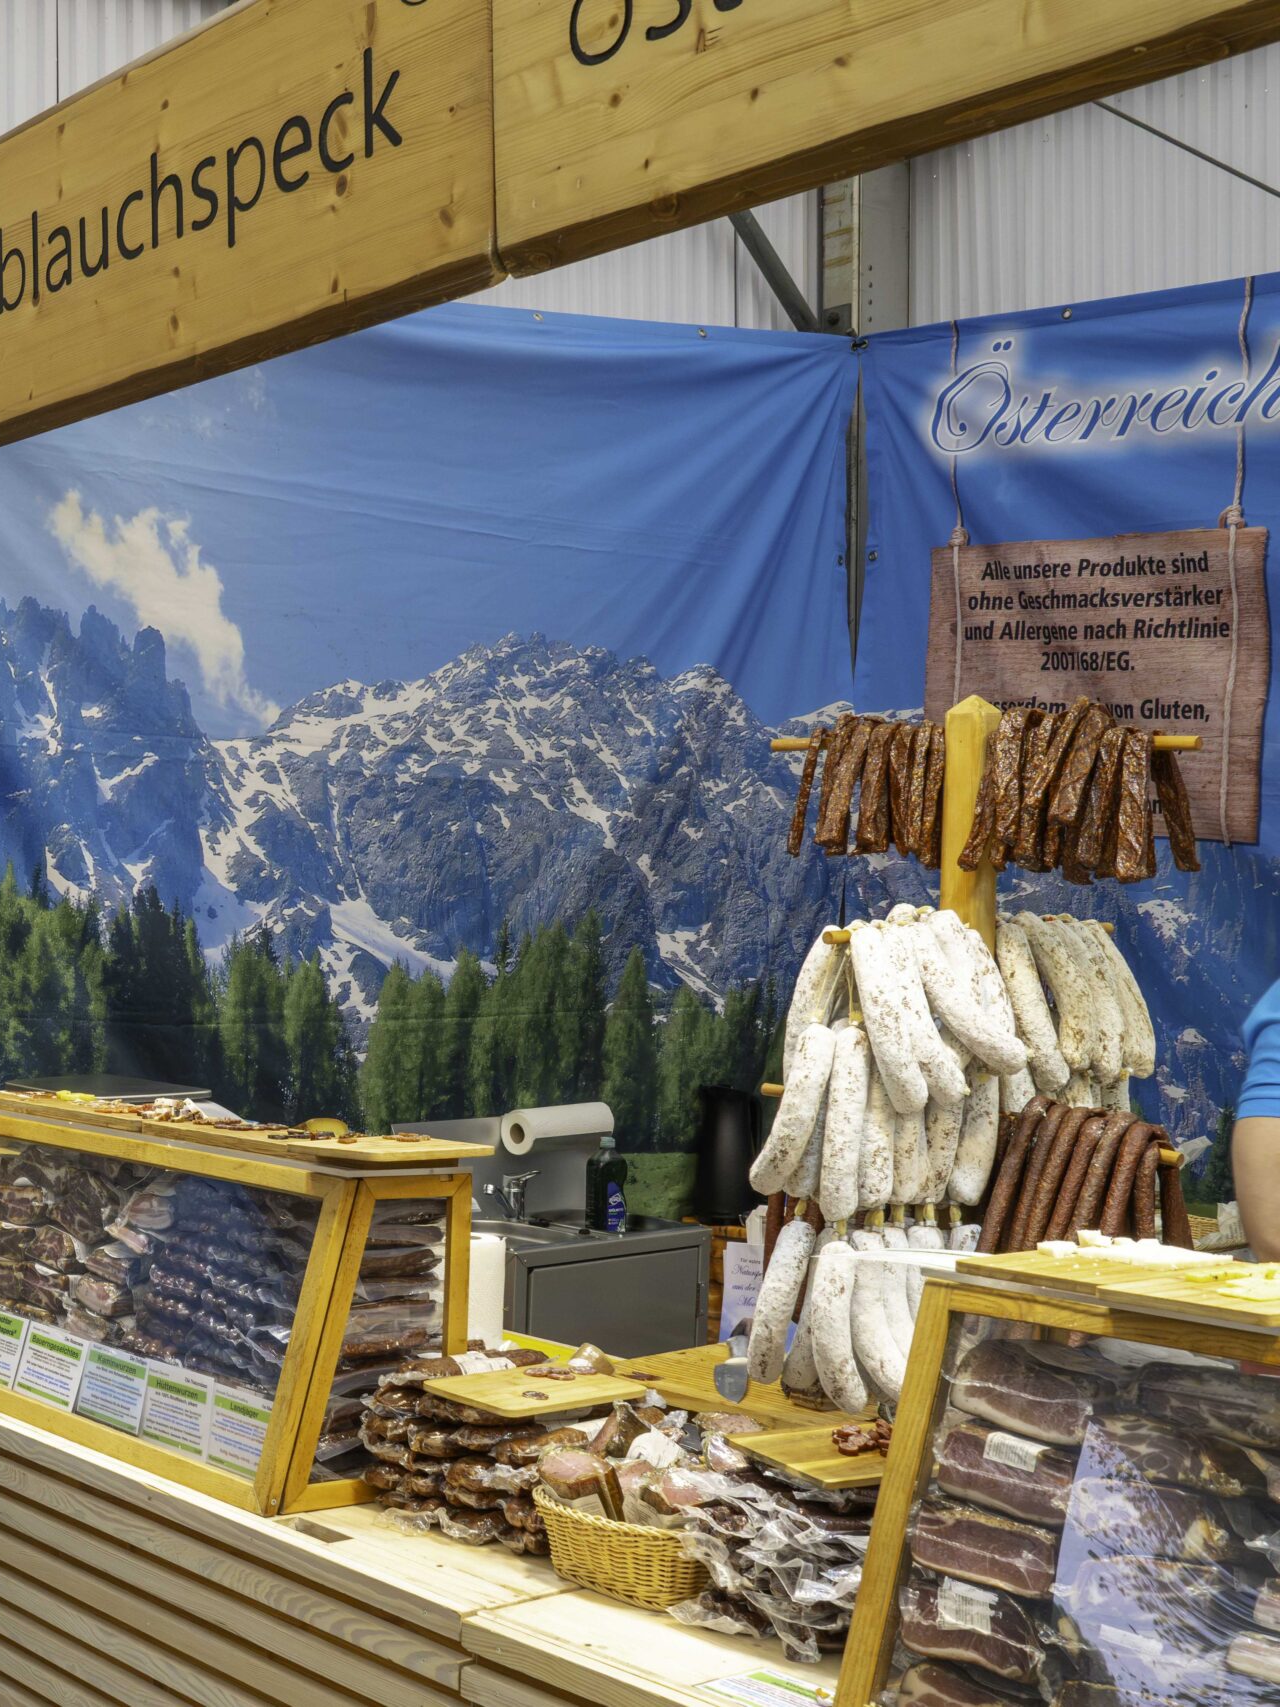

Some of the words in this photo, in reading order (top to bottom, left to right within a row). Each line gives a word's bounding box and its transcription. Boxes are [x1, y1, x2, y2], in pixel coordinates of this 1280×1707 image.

[981, 560, 1011, 581] Alle
[1014, 562, 1072, 580] unsere
[1077, 555, 1166, 577] Produkte
[1171, 550, 1210, 575] sind
[967, 590, 1014, 611] ohne
[1018, 584, 1224, 610] Geschmacksverstärker
[964, 620, 995, 641] und
[999, 620, 1078, 646] Allergene
[1083, 618, 1127, 640] nach
[1133, 616, 1231, 639] Richtlinie
[1140, 698, 1211, 723] Gluten,
